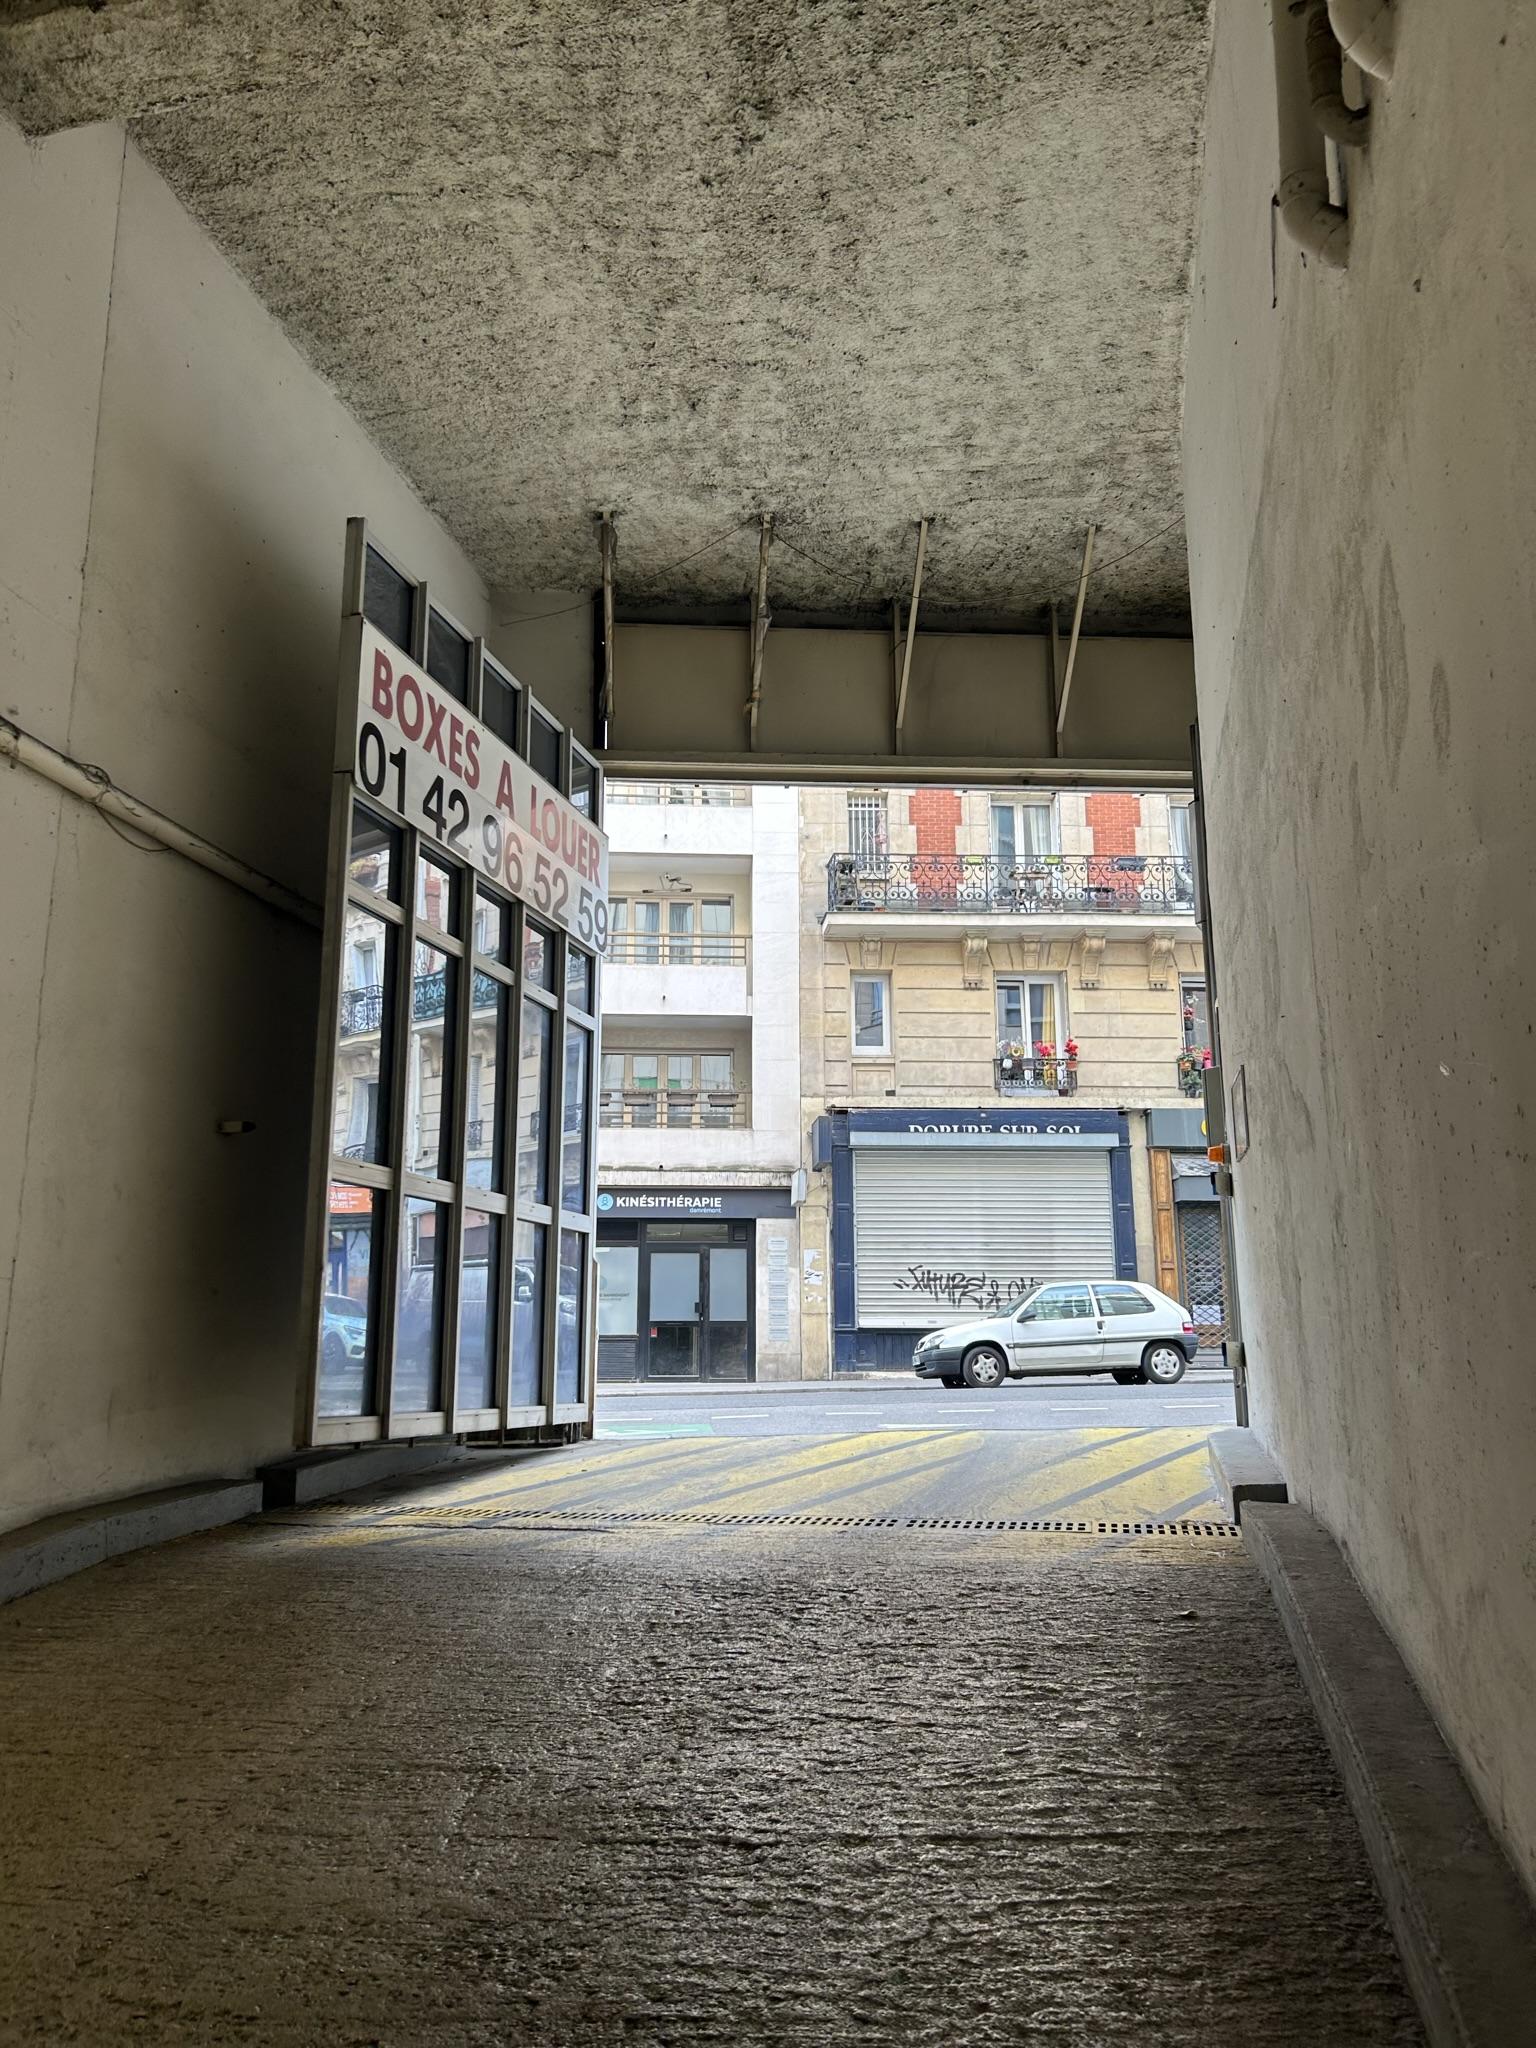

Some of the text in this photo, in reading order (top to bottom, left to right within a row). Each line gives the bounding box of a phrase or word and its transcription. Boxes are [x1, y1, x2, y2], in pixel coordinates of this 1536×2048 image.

[359, 721, 609, 955] 01 42 96 52 59
[372, 647, 600, 888] BOXES A LOUER
[616, 1194, 722, 1208] KINÉSITHÉRAPIE
